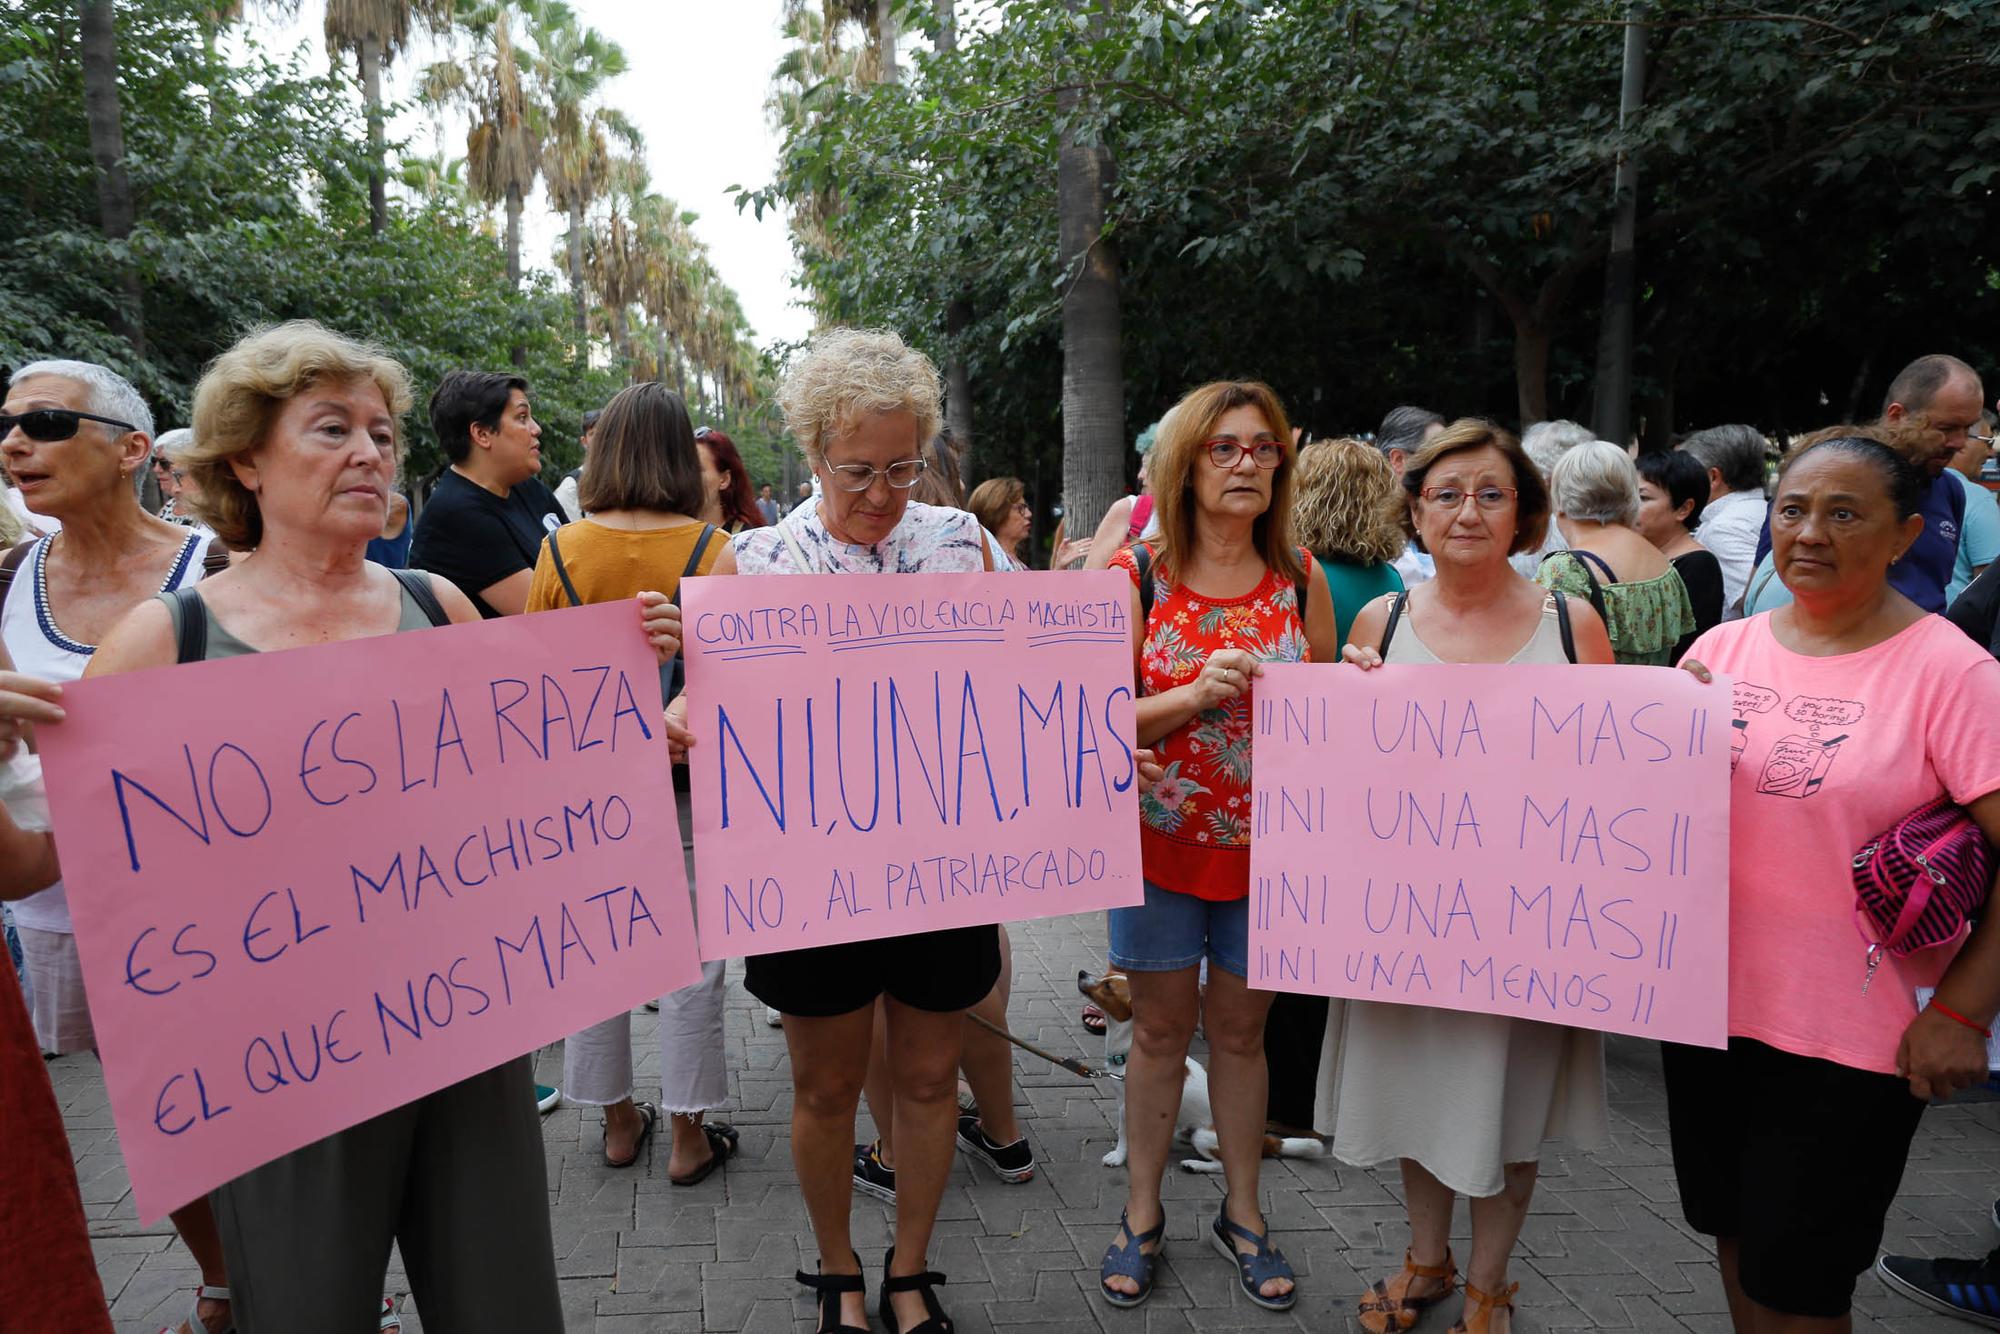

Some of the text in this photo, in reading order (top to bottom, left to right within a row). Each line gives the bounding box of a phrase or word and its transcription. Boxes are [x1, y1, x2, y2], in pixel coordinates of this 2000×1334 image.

[697, 604, 817, 644] CONTRA
[1029, 600, 1125, 630] MACHISTA
[1743, 692, 1761, 700] are
[1802, 701, 1822, 709] you
[1373, 699, 1486, 759] UNA
[111, 666, 652, 873] NO ES LA RAZA
[1368, 787, 1482, 850] UNA
[124, 795, 631, 996] ES EL MACHISMO
[827, 869, 872, 920] AL
[1365, 879, 1479, 941] UNA
[1346, 951, 1431, 992] UNA
[154, 886, 662, 1136] EL QUE NOS MATA
